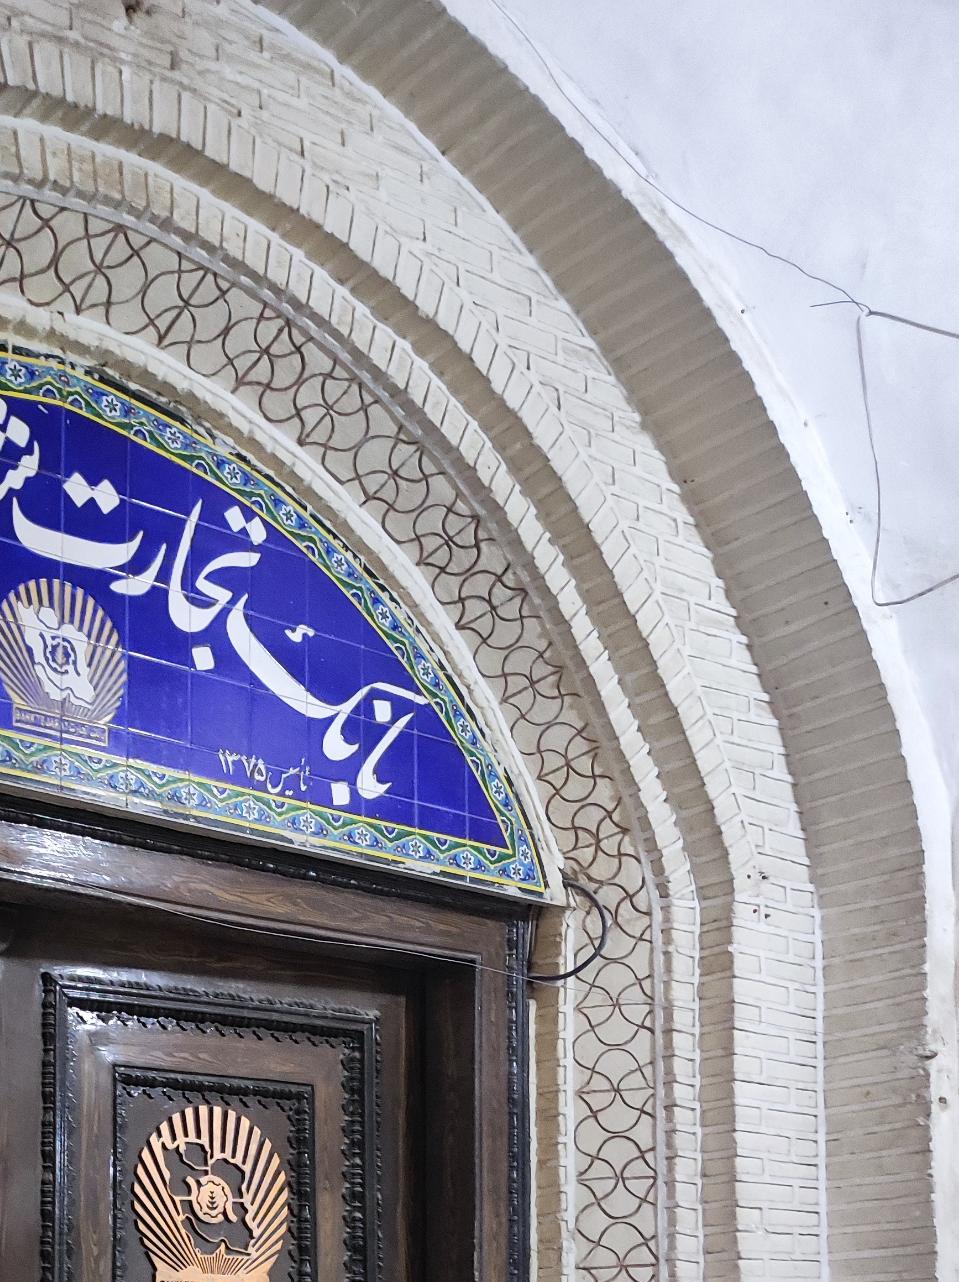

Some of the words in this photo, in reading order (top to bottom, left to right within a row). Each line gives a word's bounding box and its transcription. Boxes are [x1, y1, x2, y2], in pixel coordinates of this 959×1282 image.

[12, 472, 268, 671] تجارت
[218, 748, 267, 782] ۱۳۷۵
[226, 592, 431, 805] بانک
